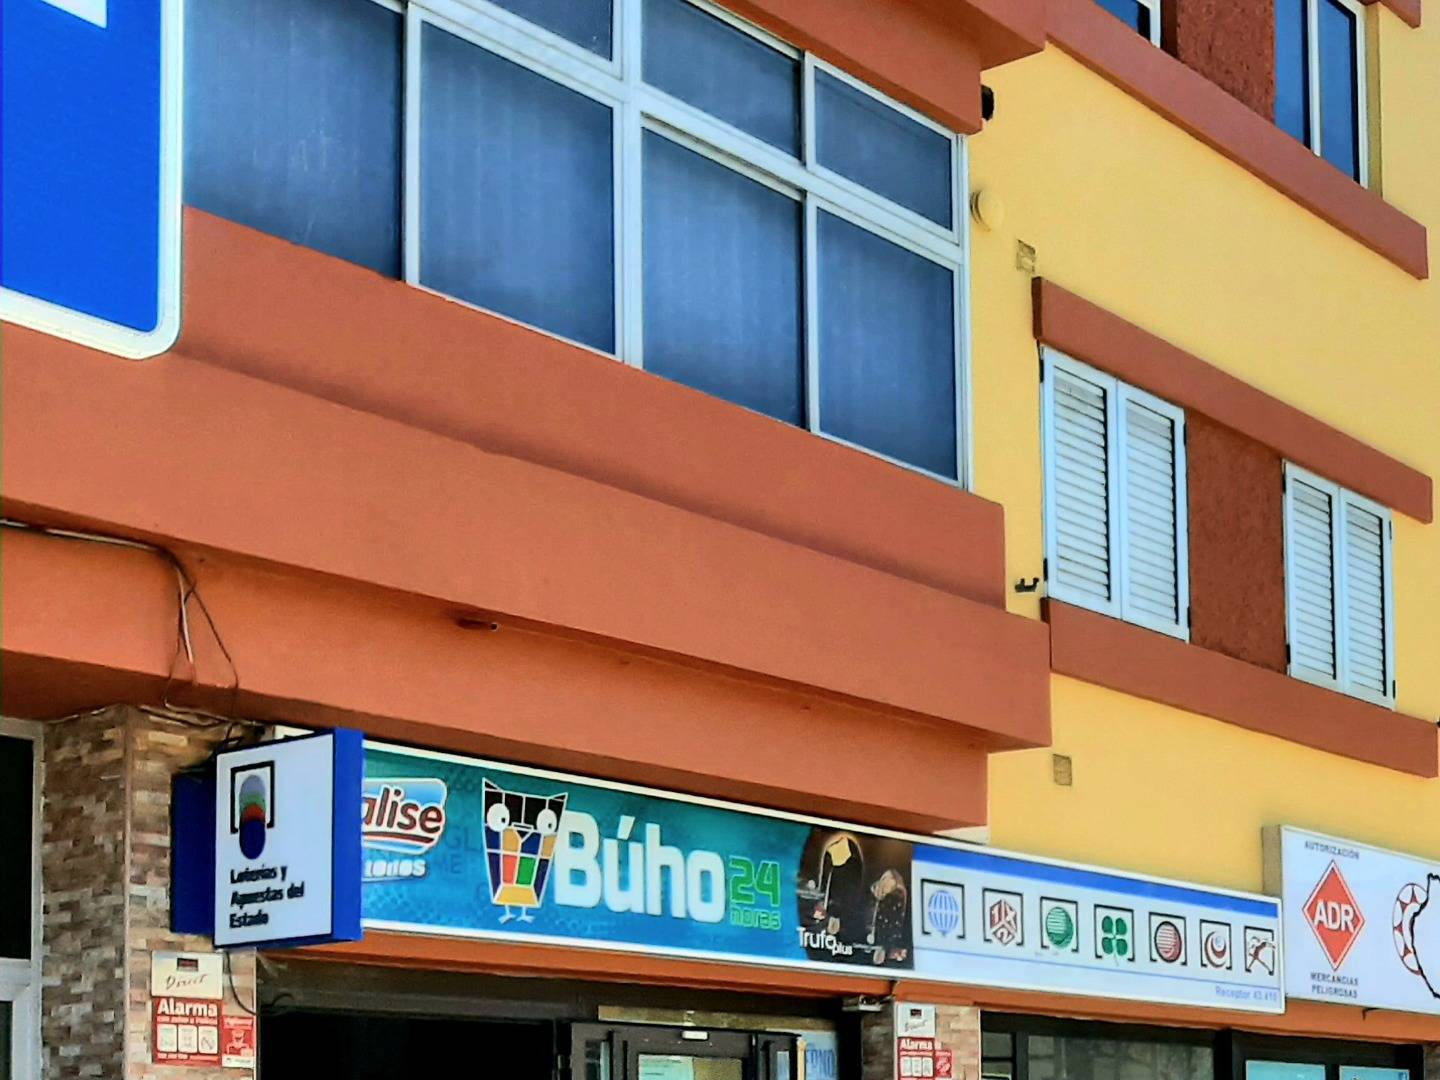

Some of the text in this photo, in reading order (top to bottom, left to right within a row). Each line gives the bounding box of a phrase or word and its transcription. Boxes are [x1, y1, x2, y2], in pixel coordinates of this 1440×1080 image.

[363, 786, 443, 834] alise
[554, 810, 726, 924] Búho
[729, 855, 781, 908] 24
[230, 881, 305, 910] Apuestas del
[229, 909, 269, 928] Estado
[1314, 899, 1355, 934] ADR
[157, 998, 219, 1017] Alarma
[899, 1038, 933, 1051] Alarma
